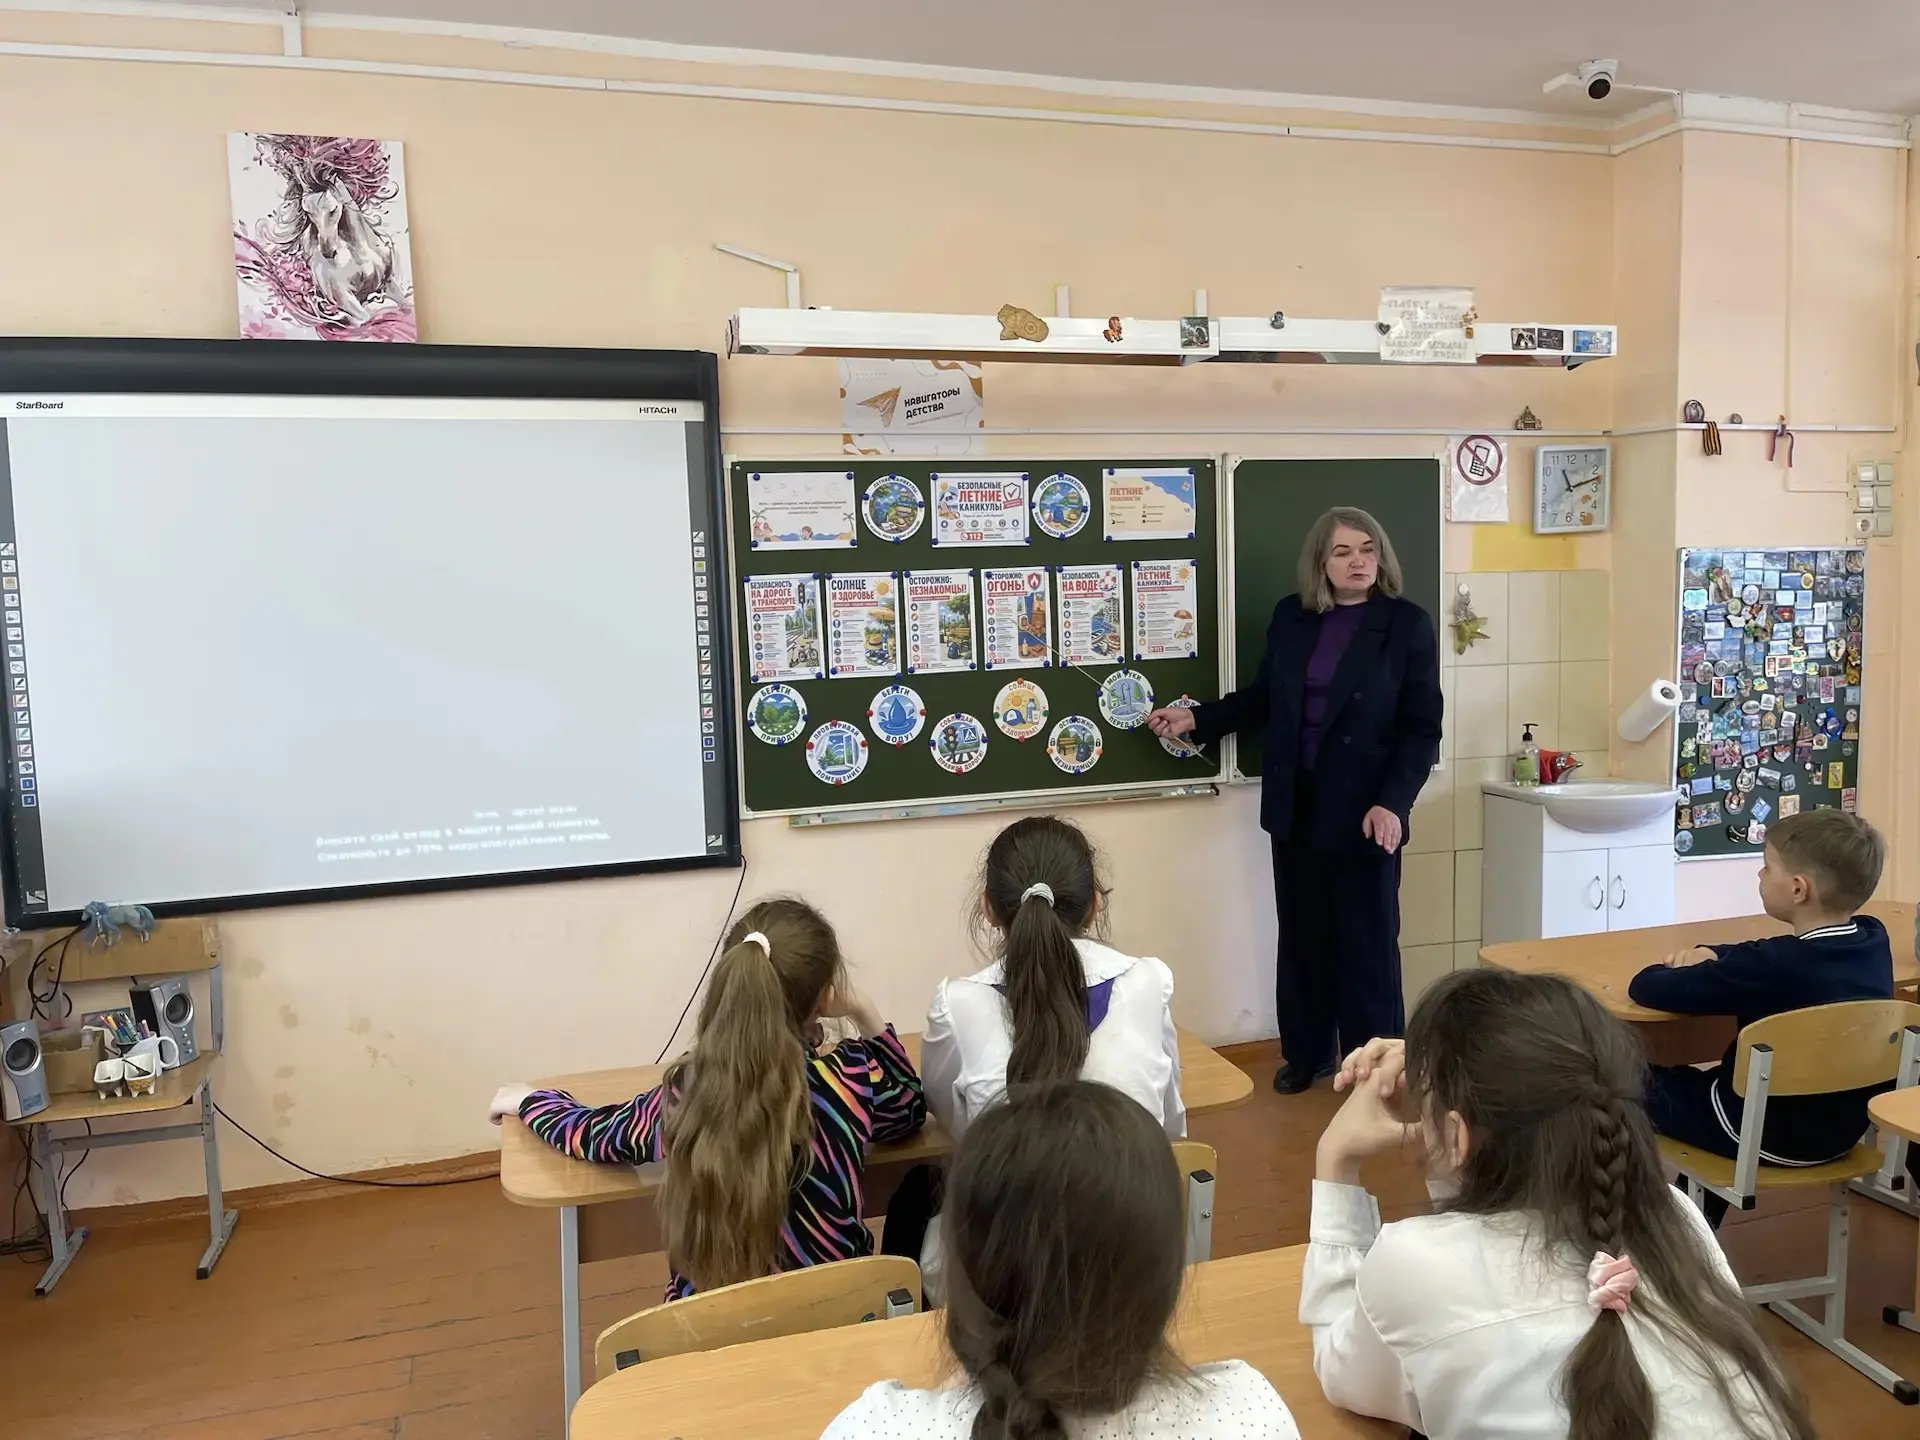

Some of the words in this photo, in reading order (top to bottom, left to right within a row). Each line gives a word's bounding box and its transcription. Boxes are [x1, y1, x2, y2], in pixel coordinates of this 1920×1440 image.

[904, 387, 960, 407] НАВИГАТОРЫ
[16, 401, 64, 409] StarBoard
[906, 402, 944, 419] ДЕТСТВА
[1552, 454, 1559, 464] 11
[1566, 454, 1576, 464] 12
[1584, 454, 1588, 463] 1
[1542, 466, 1552, 477] 10
[1592, 464, 1599, 475] 2
[958, 482, 1001, 490] БЕЗОПАСНЫЕ
[1591, 482, 1598, 492] 3
[959, 490, 1002, 502] ЛЕТНИЕ
[959, 503, 1002, 511] КАНИКУЛЫ
[1541, 502, 1547, 513] 8
[1591, 500, 1598, 509] 4
[1552, 512, 1558, 523] 7
[1566, 512, 1572, 522] 6
[1580, 511, 1586, 521] 5
[909, 576, 952, 585] ОСТОРОЖНО:
[990, 572, 1024, 580] СТОРОЖНО:
[1062, 572, 1100, 580] БЕЗОПАСНОСТЬ
[1138, 571, 1171, 580] ЛЕТНИЕ
[750, 580, 792, 589] БЕЗОПАСНОСТЬ
[831, 580, 866, 590] СОЛНЦЕ
[909, 584, 967, 595] НЕЗНАКОМЦЫ!
[987, 580, 1025, 591] ОГОНЬ!
[1062, 581, 1074, 591] НА
[1076, 580, 1098, 592] ВОДЕ
[751, 590, 761, 598] НА
[763, 588, 792, 598] ДОРОГЕ
[832, 592, 837, 600] И
[838, 591, 874, 601] ЗДОРОВЬЕ
[757, 597, 796, 606] ТРАНСПОРТЕ
[1107, 672, 1122, 685] МОЙ
[940, 715, 974, 728] СОБЛДАЙ
[1109, 716, 1130, 728] ПЕРЕД
[813, 723, 859, 740] ПРОВЕРИВАЙ
[1006, 726, 1039, 737] ЗДОРОВЬЕ!
[885, 733, 914, 743] ВОДУ!
[964, 750, 984, 771] ДОРОГИ!
